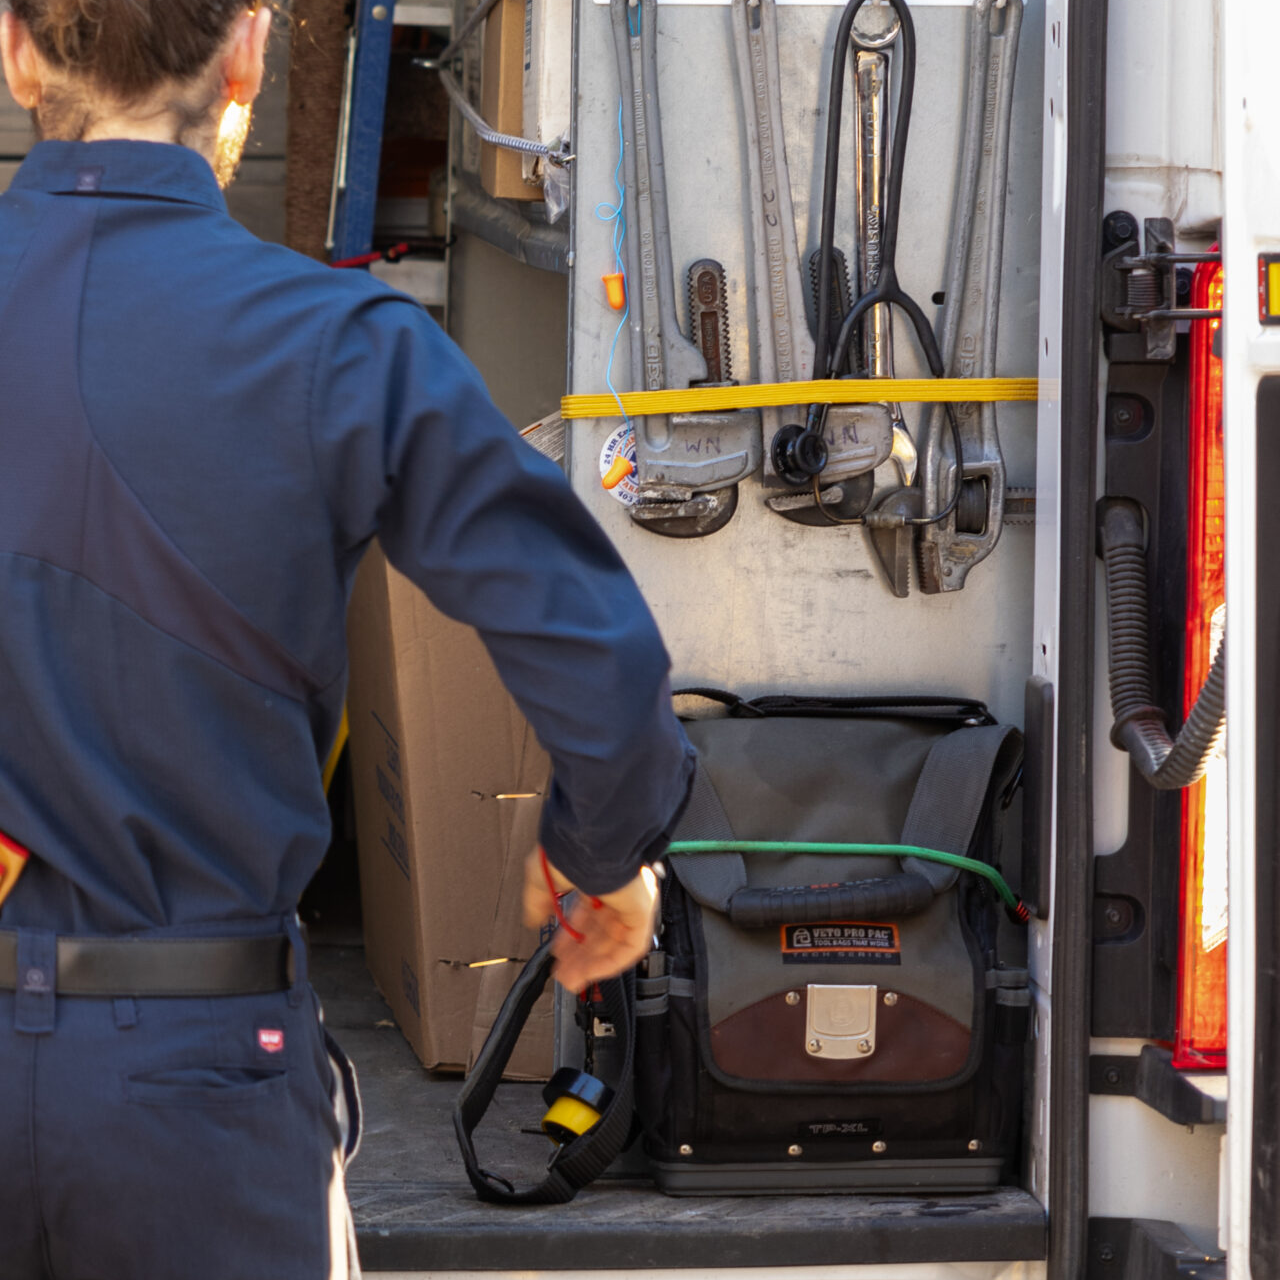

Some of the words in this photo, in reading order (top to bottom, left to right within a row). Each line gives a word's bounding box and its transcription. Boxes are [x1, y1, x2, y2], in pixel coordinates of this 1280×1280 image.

[866, 209, 880, 265] HUSKY
[769, 237, 787, 319] GUARANTEED
[607, 438, 618, 453] HR
[604, 454, 611, 465] 24
[812, 928, 841, 938] VETO
[844, 928, 865, 938] PRO
[868, 928, 889, 939] PAC
[814, 939, 832, 947] TOOL
[869, 939, 890, 947] WORK
